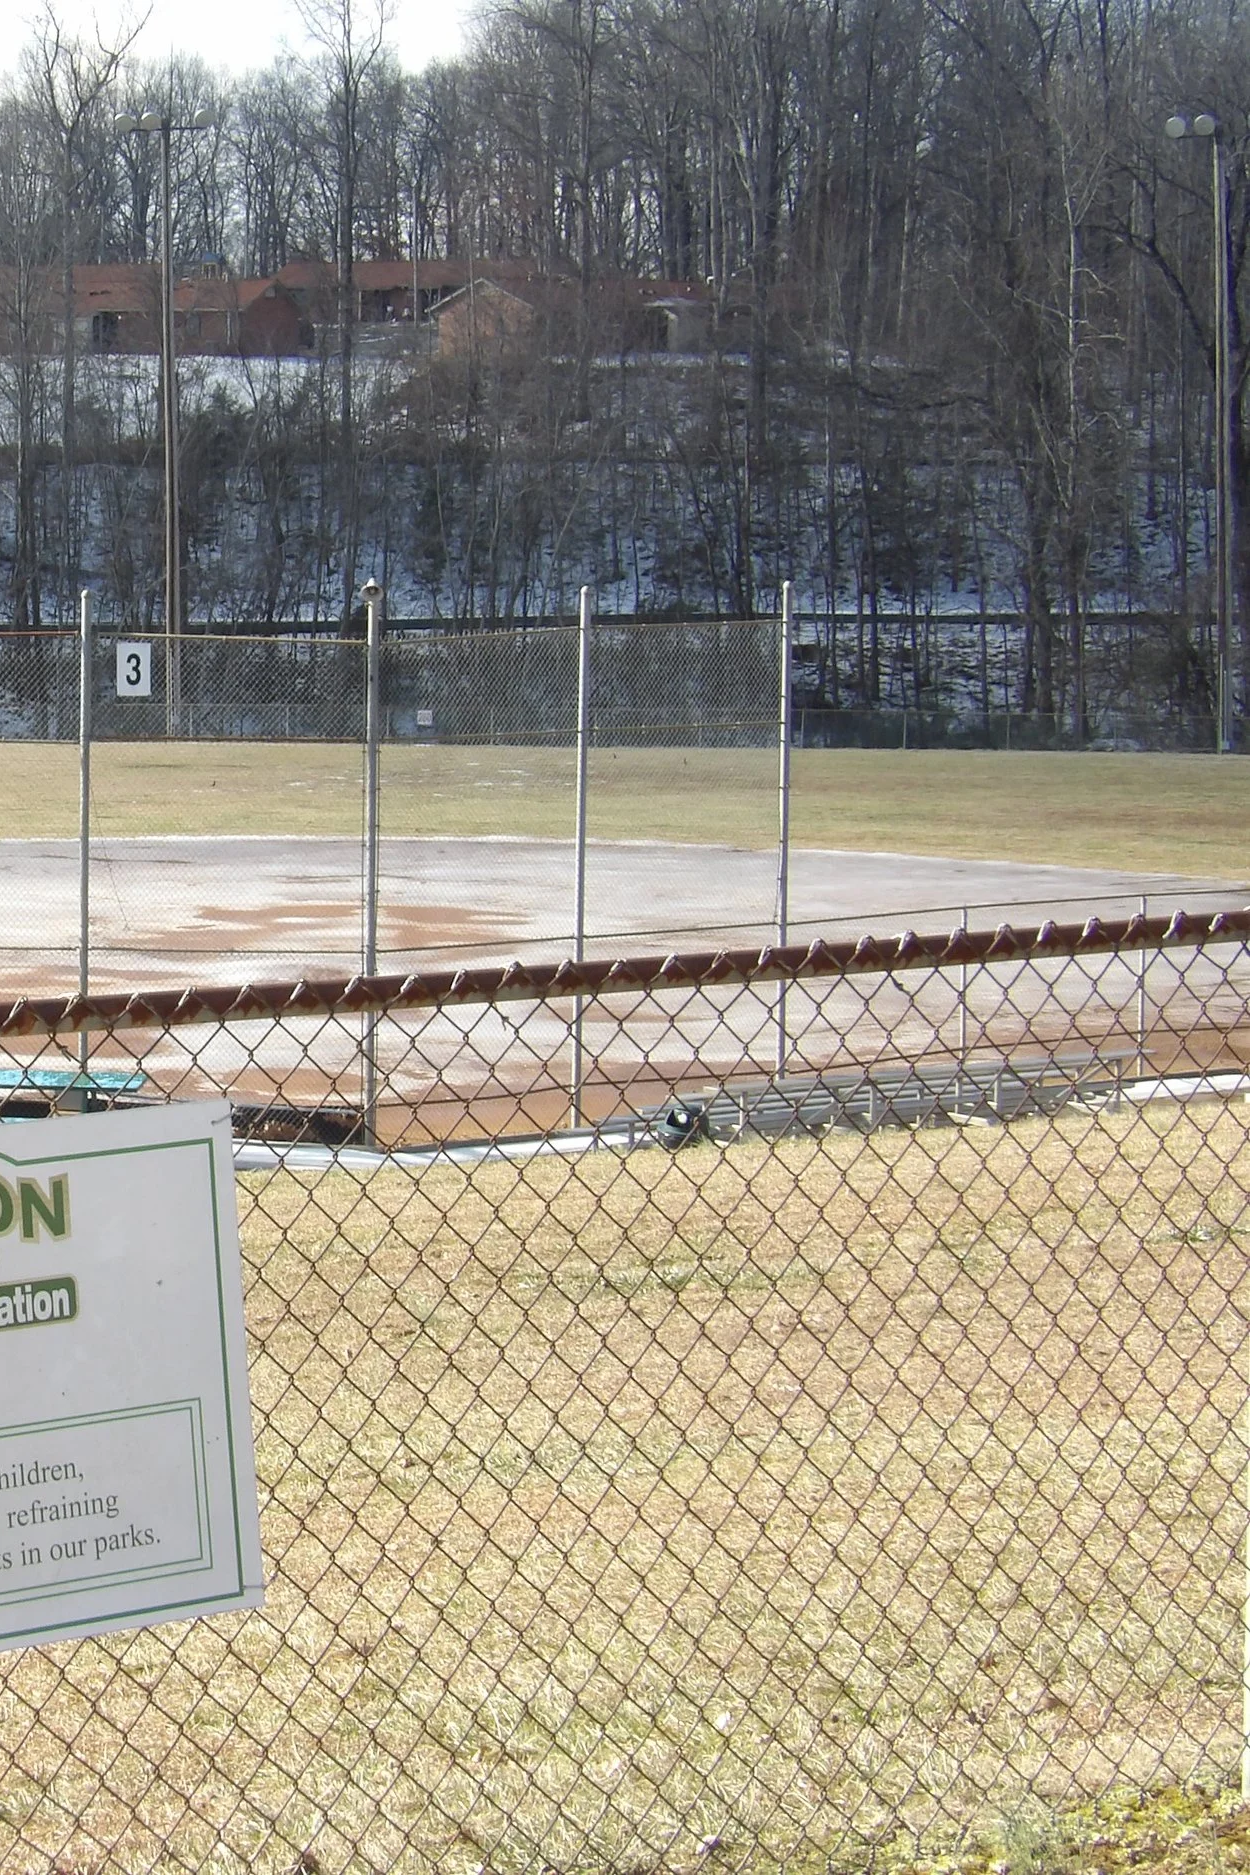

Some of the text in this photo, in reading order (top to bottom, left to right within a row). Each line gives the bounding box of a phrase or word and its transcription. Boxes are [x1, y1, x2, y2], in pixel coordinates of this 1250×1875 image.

[126, 653, 141, 686] 3
[6, 1492, 120, 1530] refraining
[21, 1542, 43, 1567] in
[49, 1538, 87, 1562] our
[94, 1523, 162, 1561] parks.
